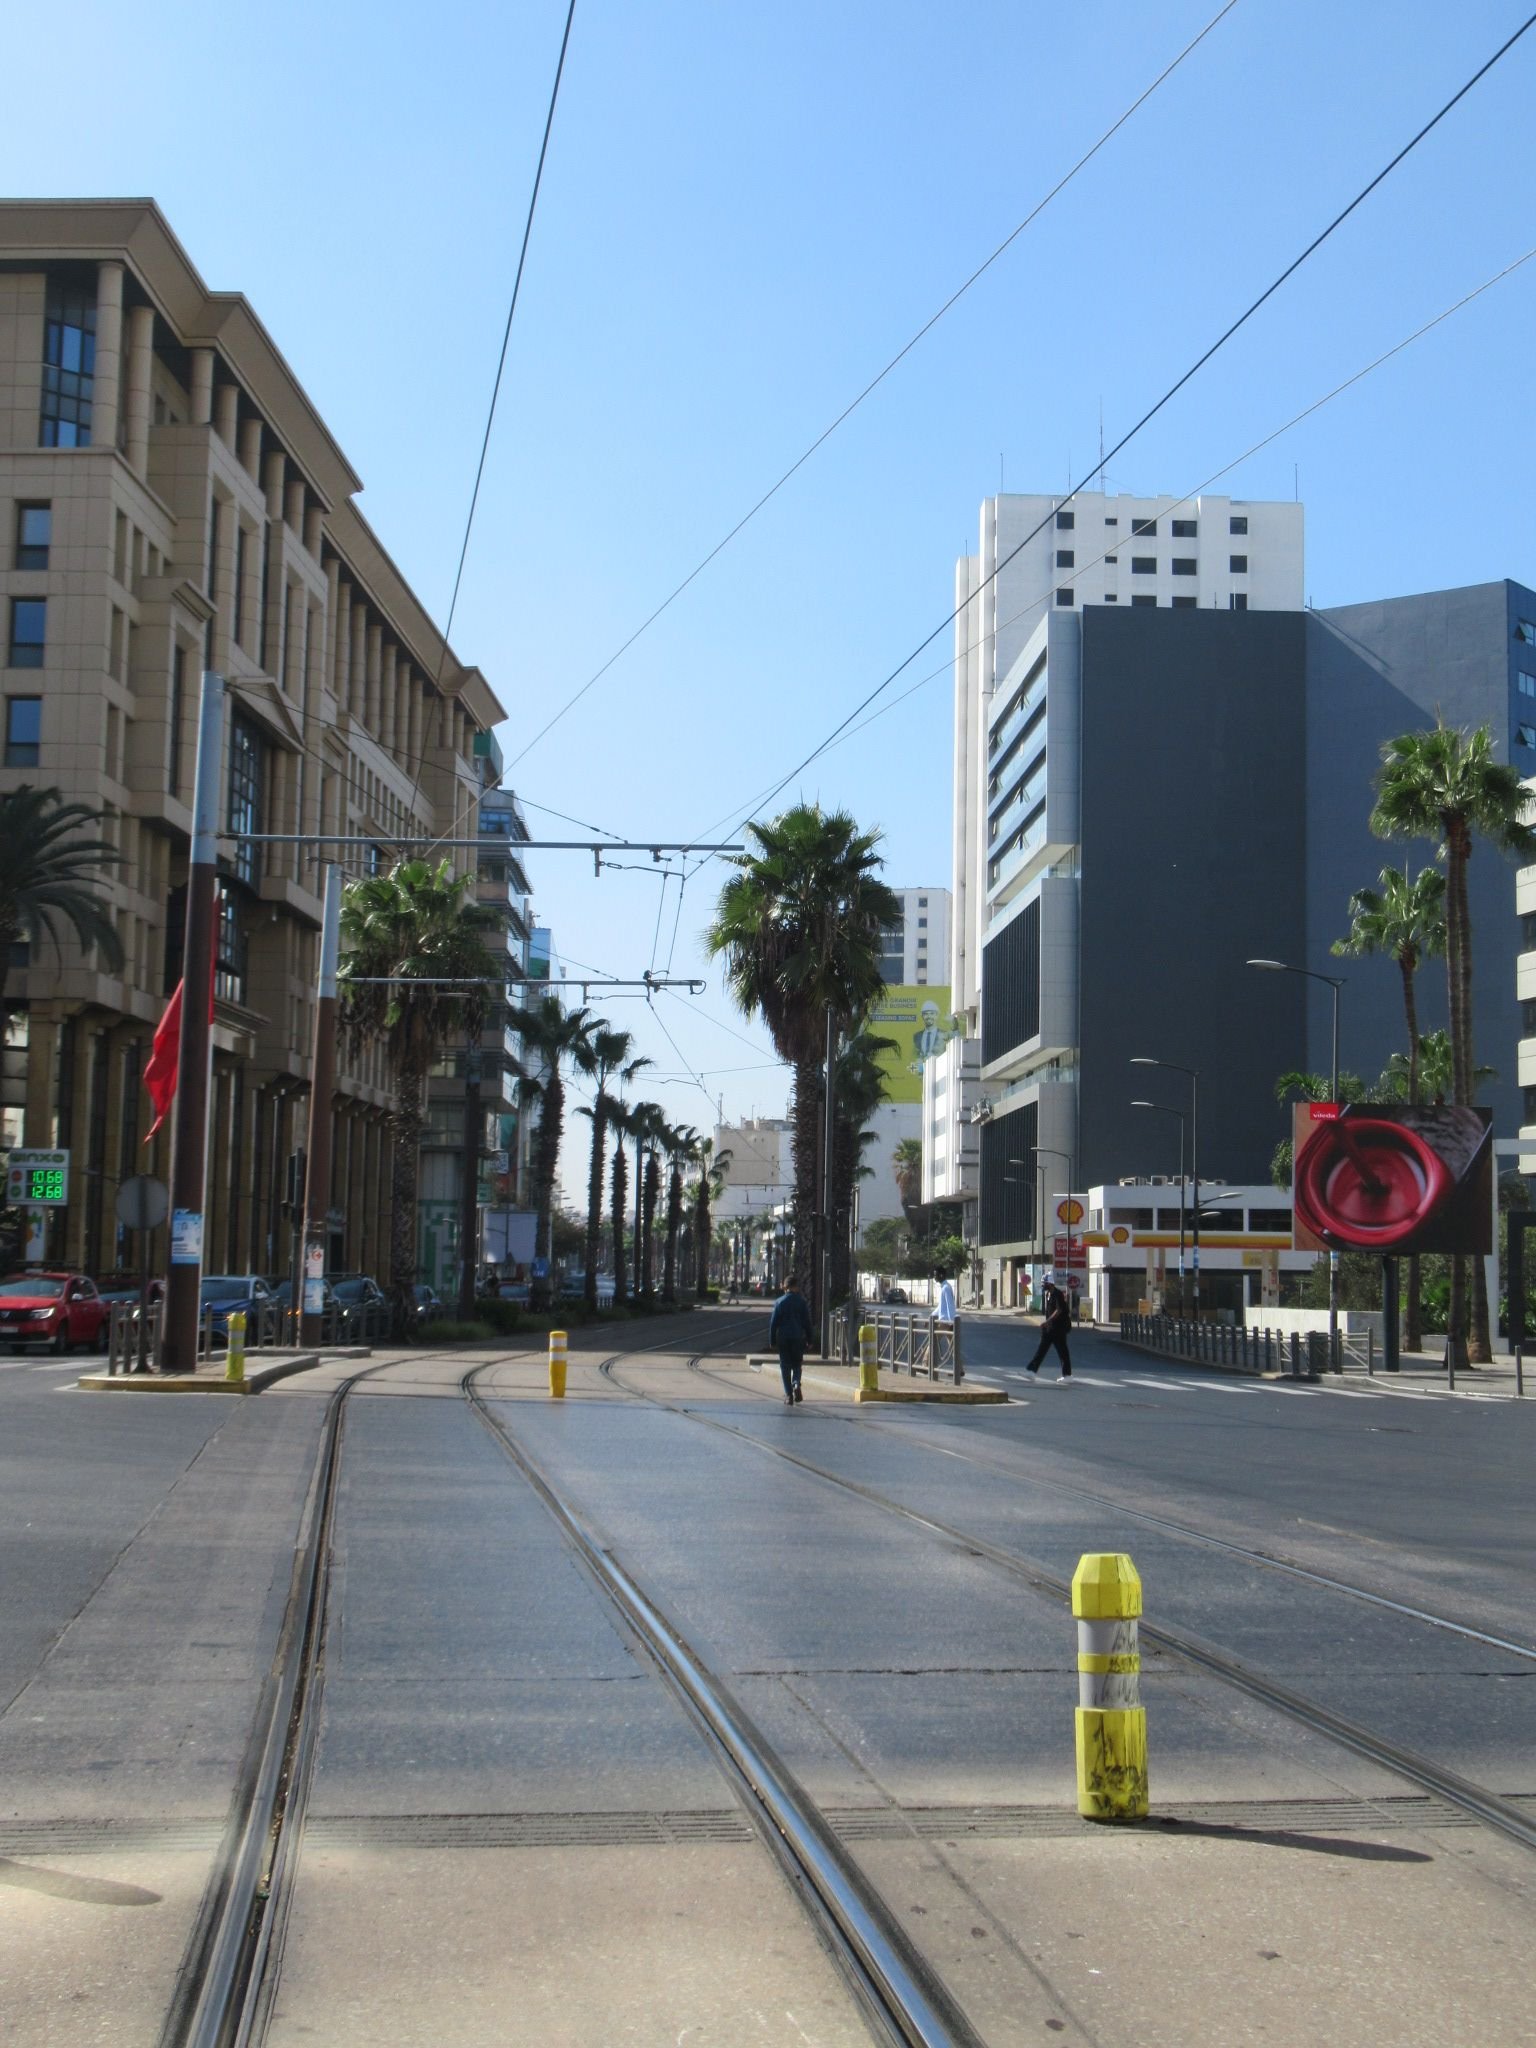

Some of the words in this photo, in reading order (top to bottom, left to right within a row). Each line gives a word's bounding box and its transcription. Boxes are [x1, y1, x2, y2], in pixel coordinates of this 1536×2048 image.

[1313, 1111, 1336, 1119] vileda
[32, 1170, 64, 1184] 10.68
[31, 1185, 63, 1199] 12.68
